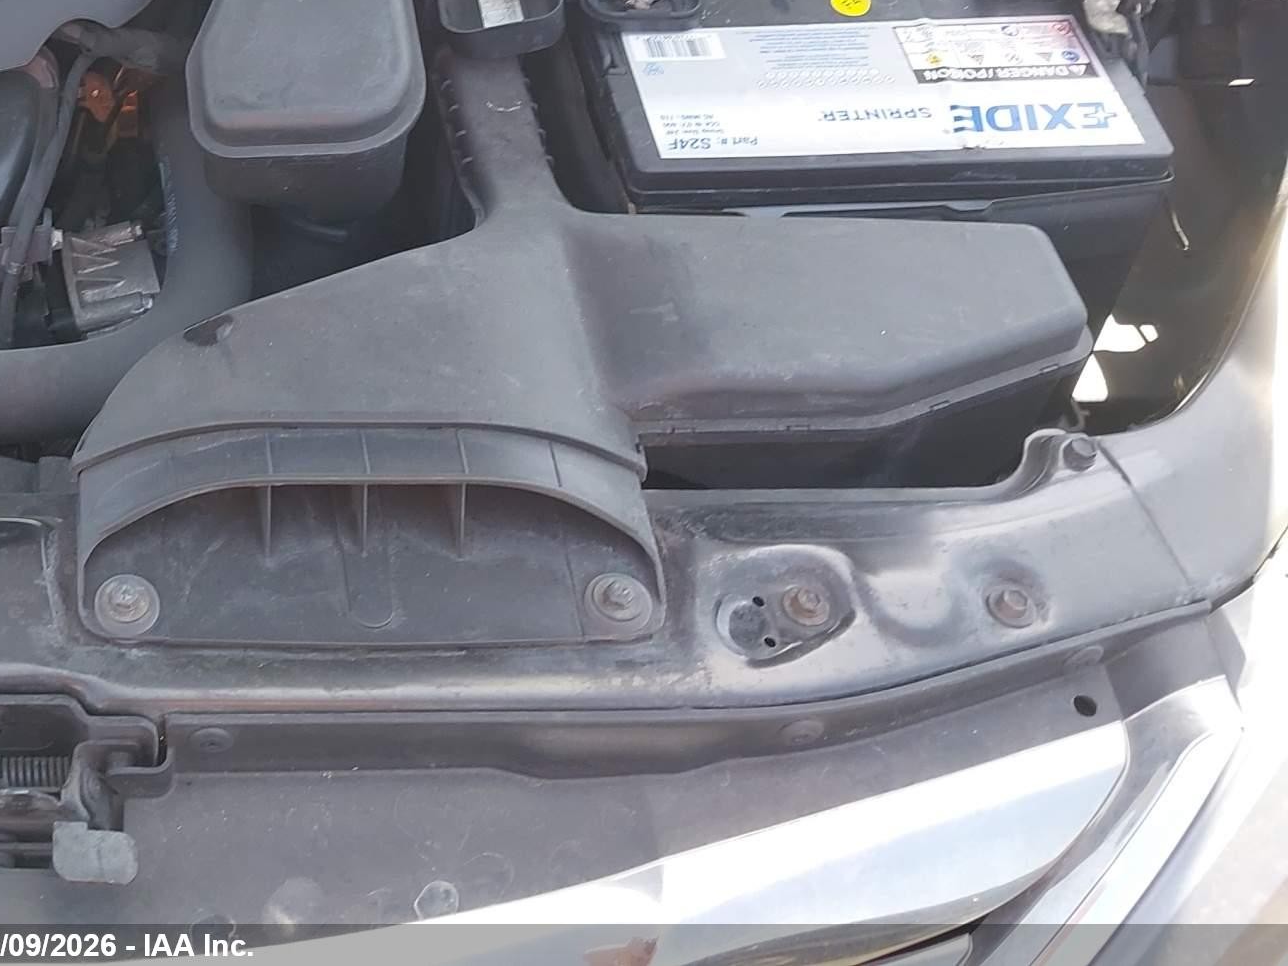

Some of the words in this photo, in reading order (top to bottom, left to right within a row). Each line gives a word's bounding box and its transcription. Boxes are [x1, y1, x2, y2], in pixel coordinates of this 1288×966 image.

[822, 107, 933, 121] SPRINTER
[949, 103, 1117, 133] EXIDE
[669, 138, 711, 151] S24F
[733, 137, 758, 146] Part
